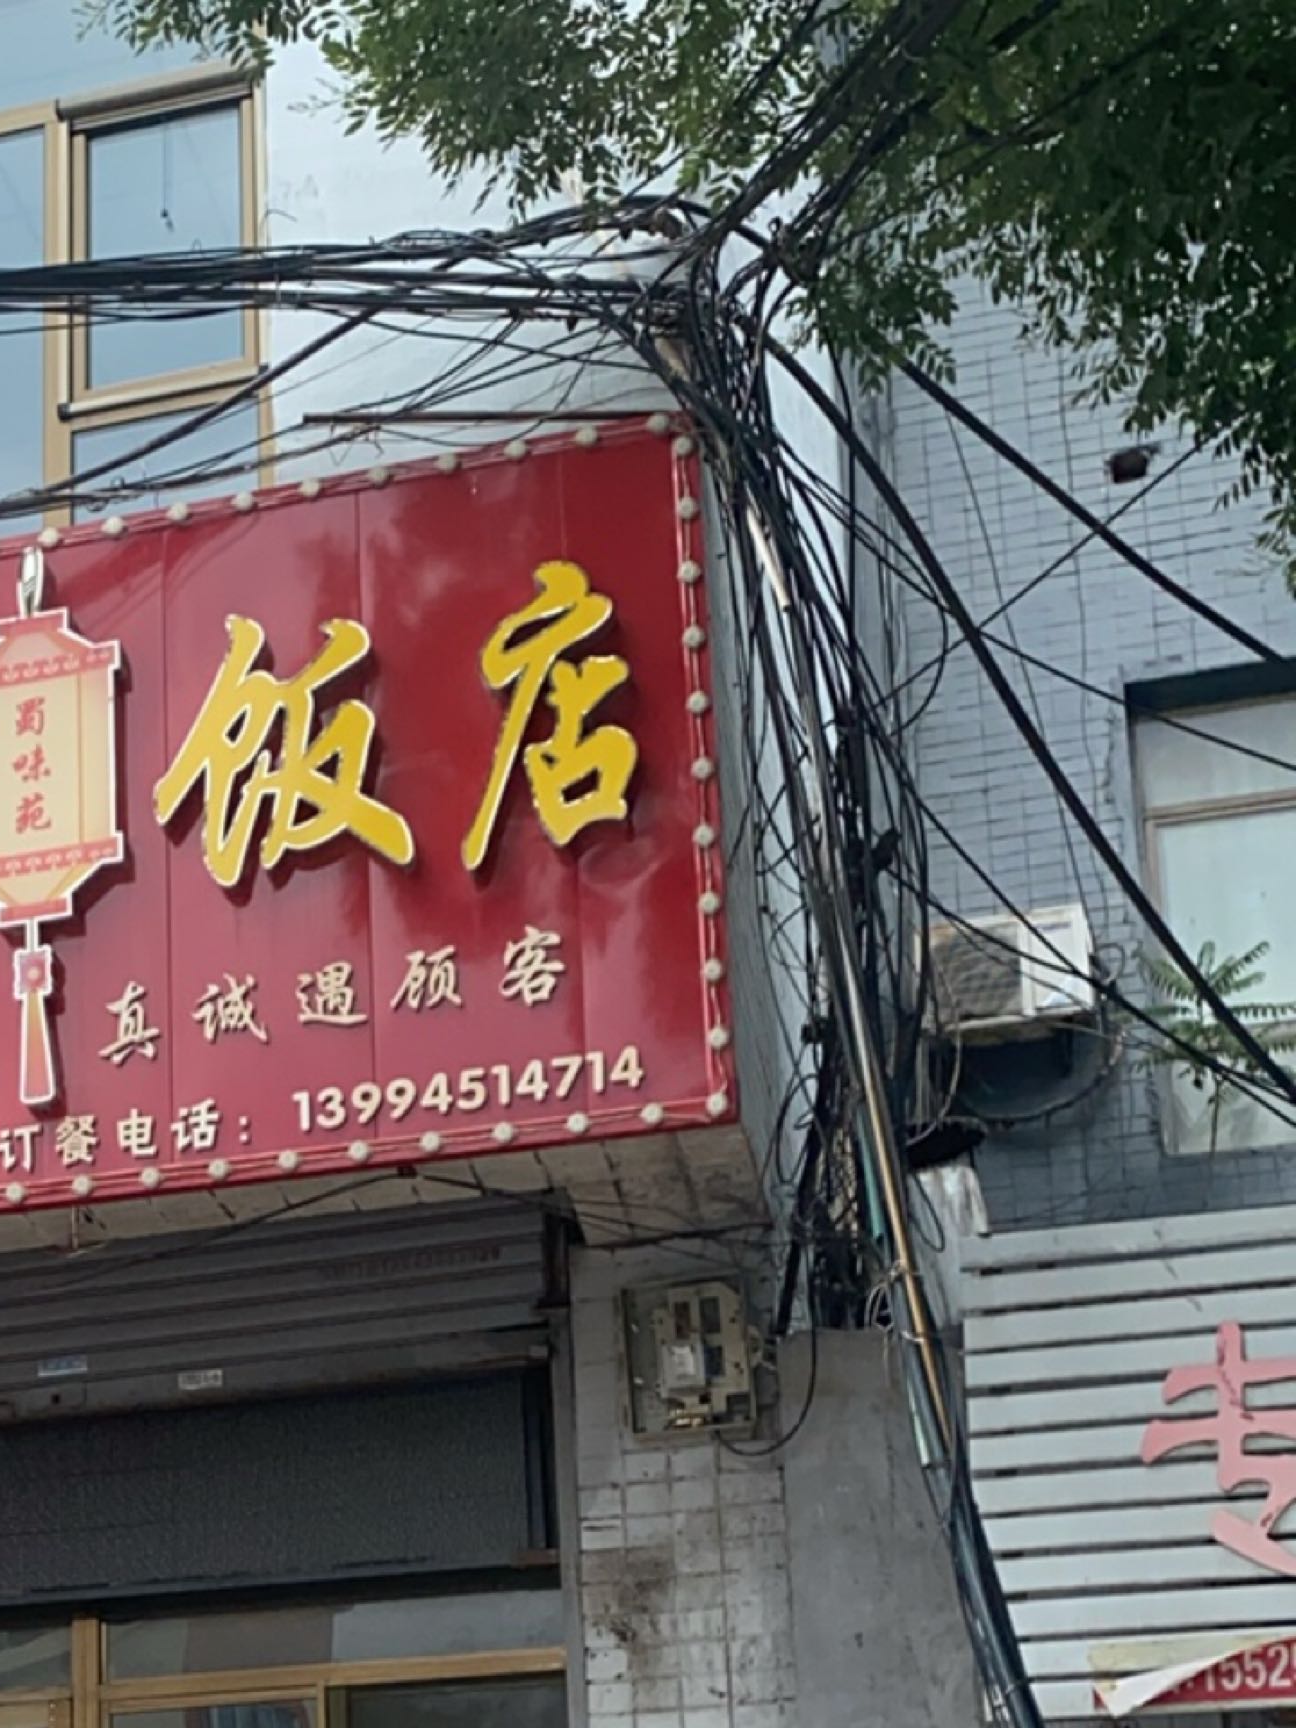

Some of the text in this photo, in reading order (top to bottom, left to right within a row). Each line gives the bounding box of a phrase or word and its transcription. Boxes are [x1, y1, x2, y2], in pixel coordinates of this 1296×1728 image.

[12, 697, 52, 834] 蜀味苑
[153, 562, 642, 888] 饭店
[99, 925, 566, 1066] 真诚遇顾客
[292, 1045, 645, 1132] 13994514714
[1206, 1641, 1296, 1693] 1552
